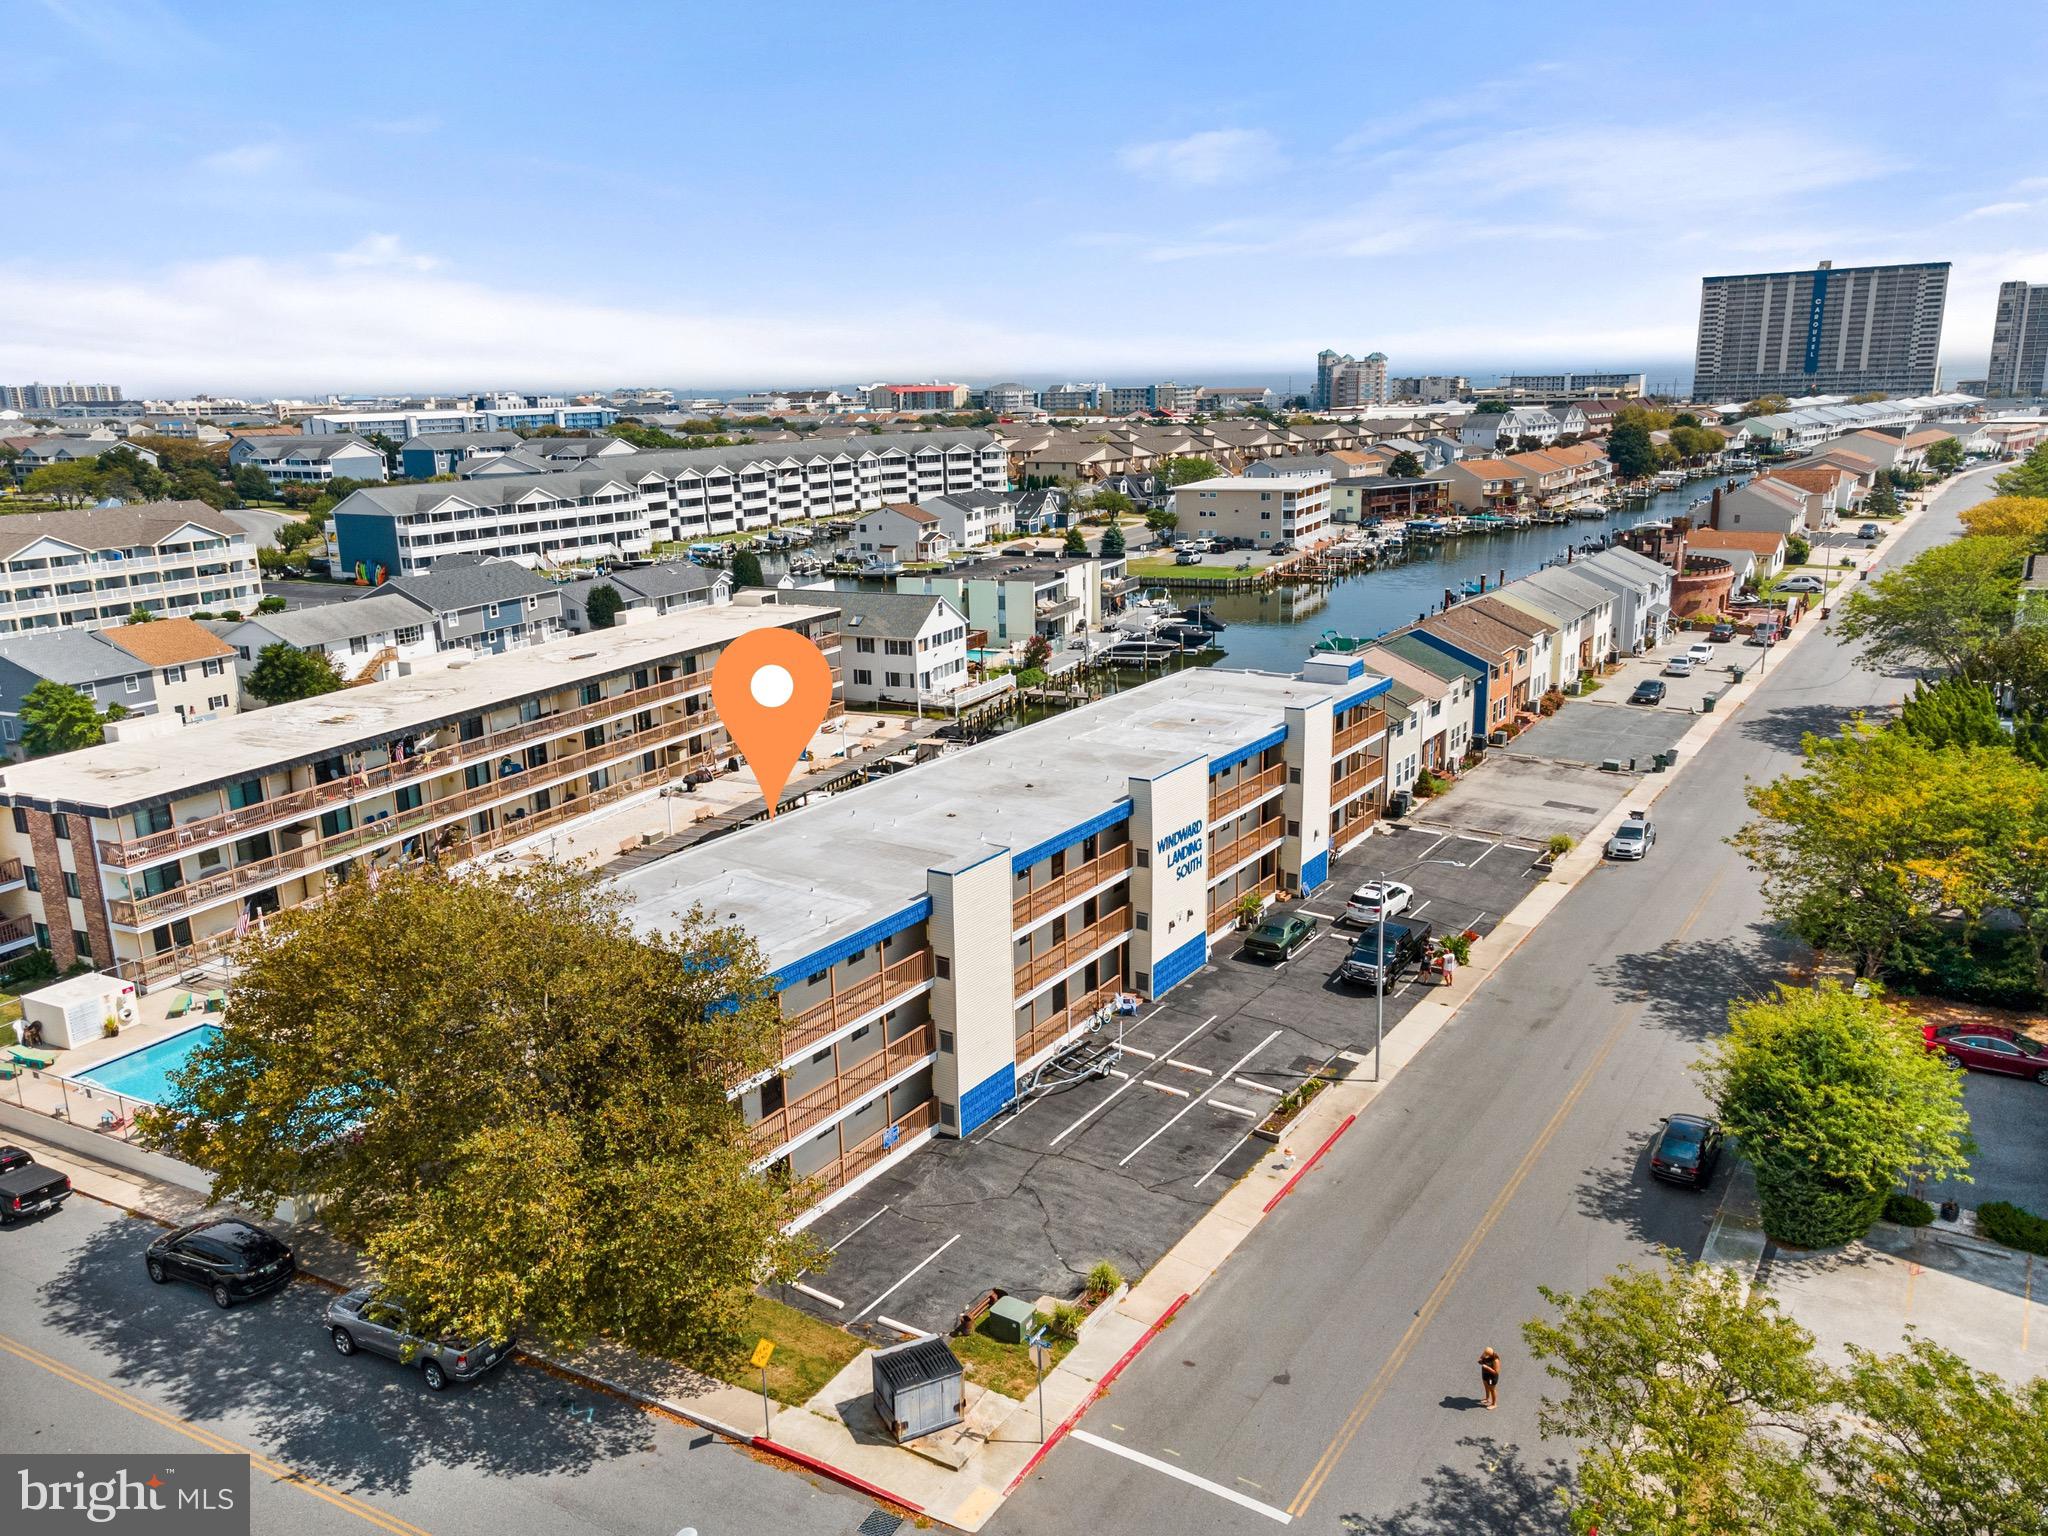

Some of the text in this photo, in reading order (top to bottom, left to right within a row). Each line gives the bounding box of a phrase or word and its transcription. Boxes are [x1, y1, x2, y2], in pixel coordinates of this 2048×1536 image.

[1810, 298, 1822, 358] CAROUSEL
[1157, 820, 1203, 854] WINDWARD
[1167, 838, 1203, 868] LANDING
[1176, 854, 1203, 881] SOUTH
